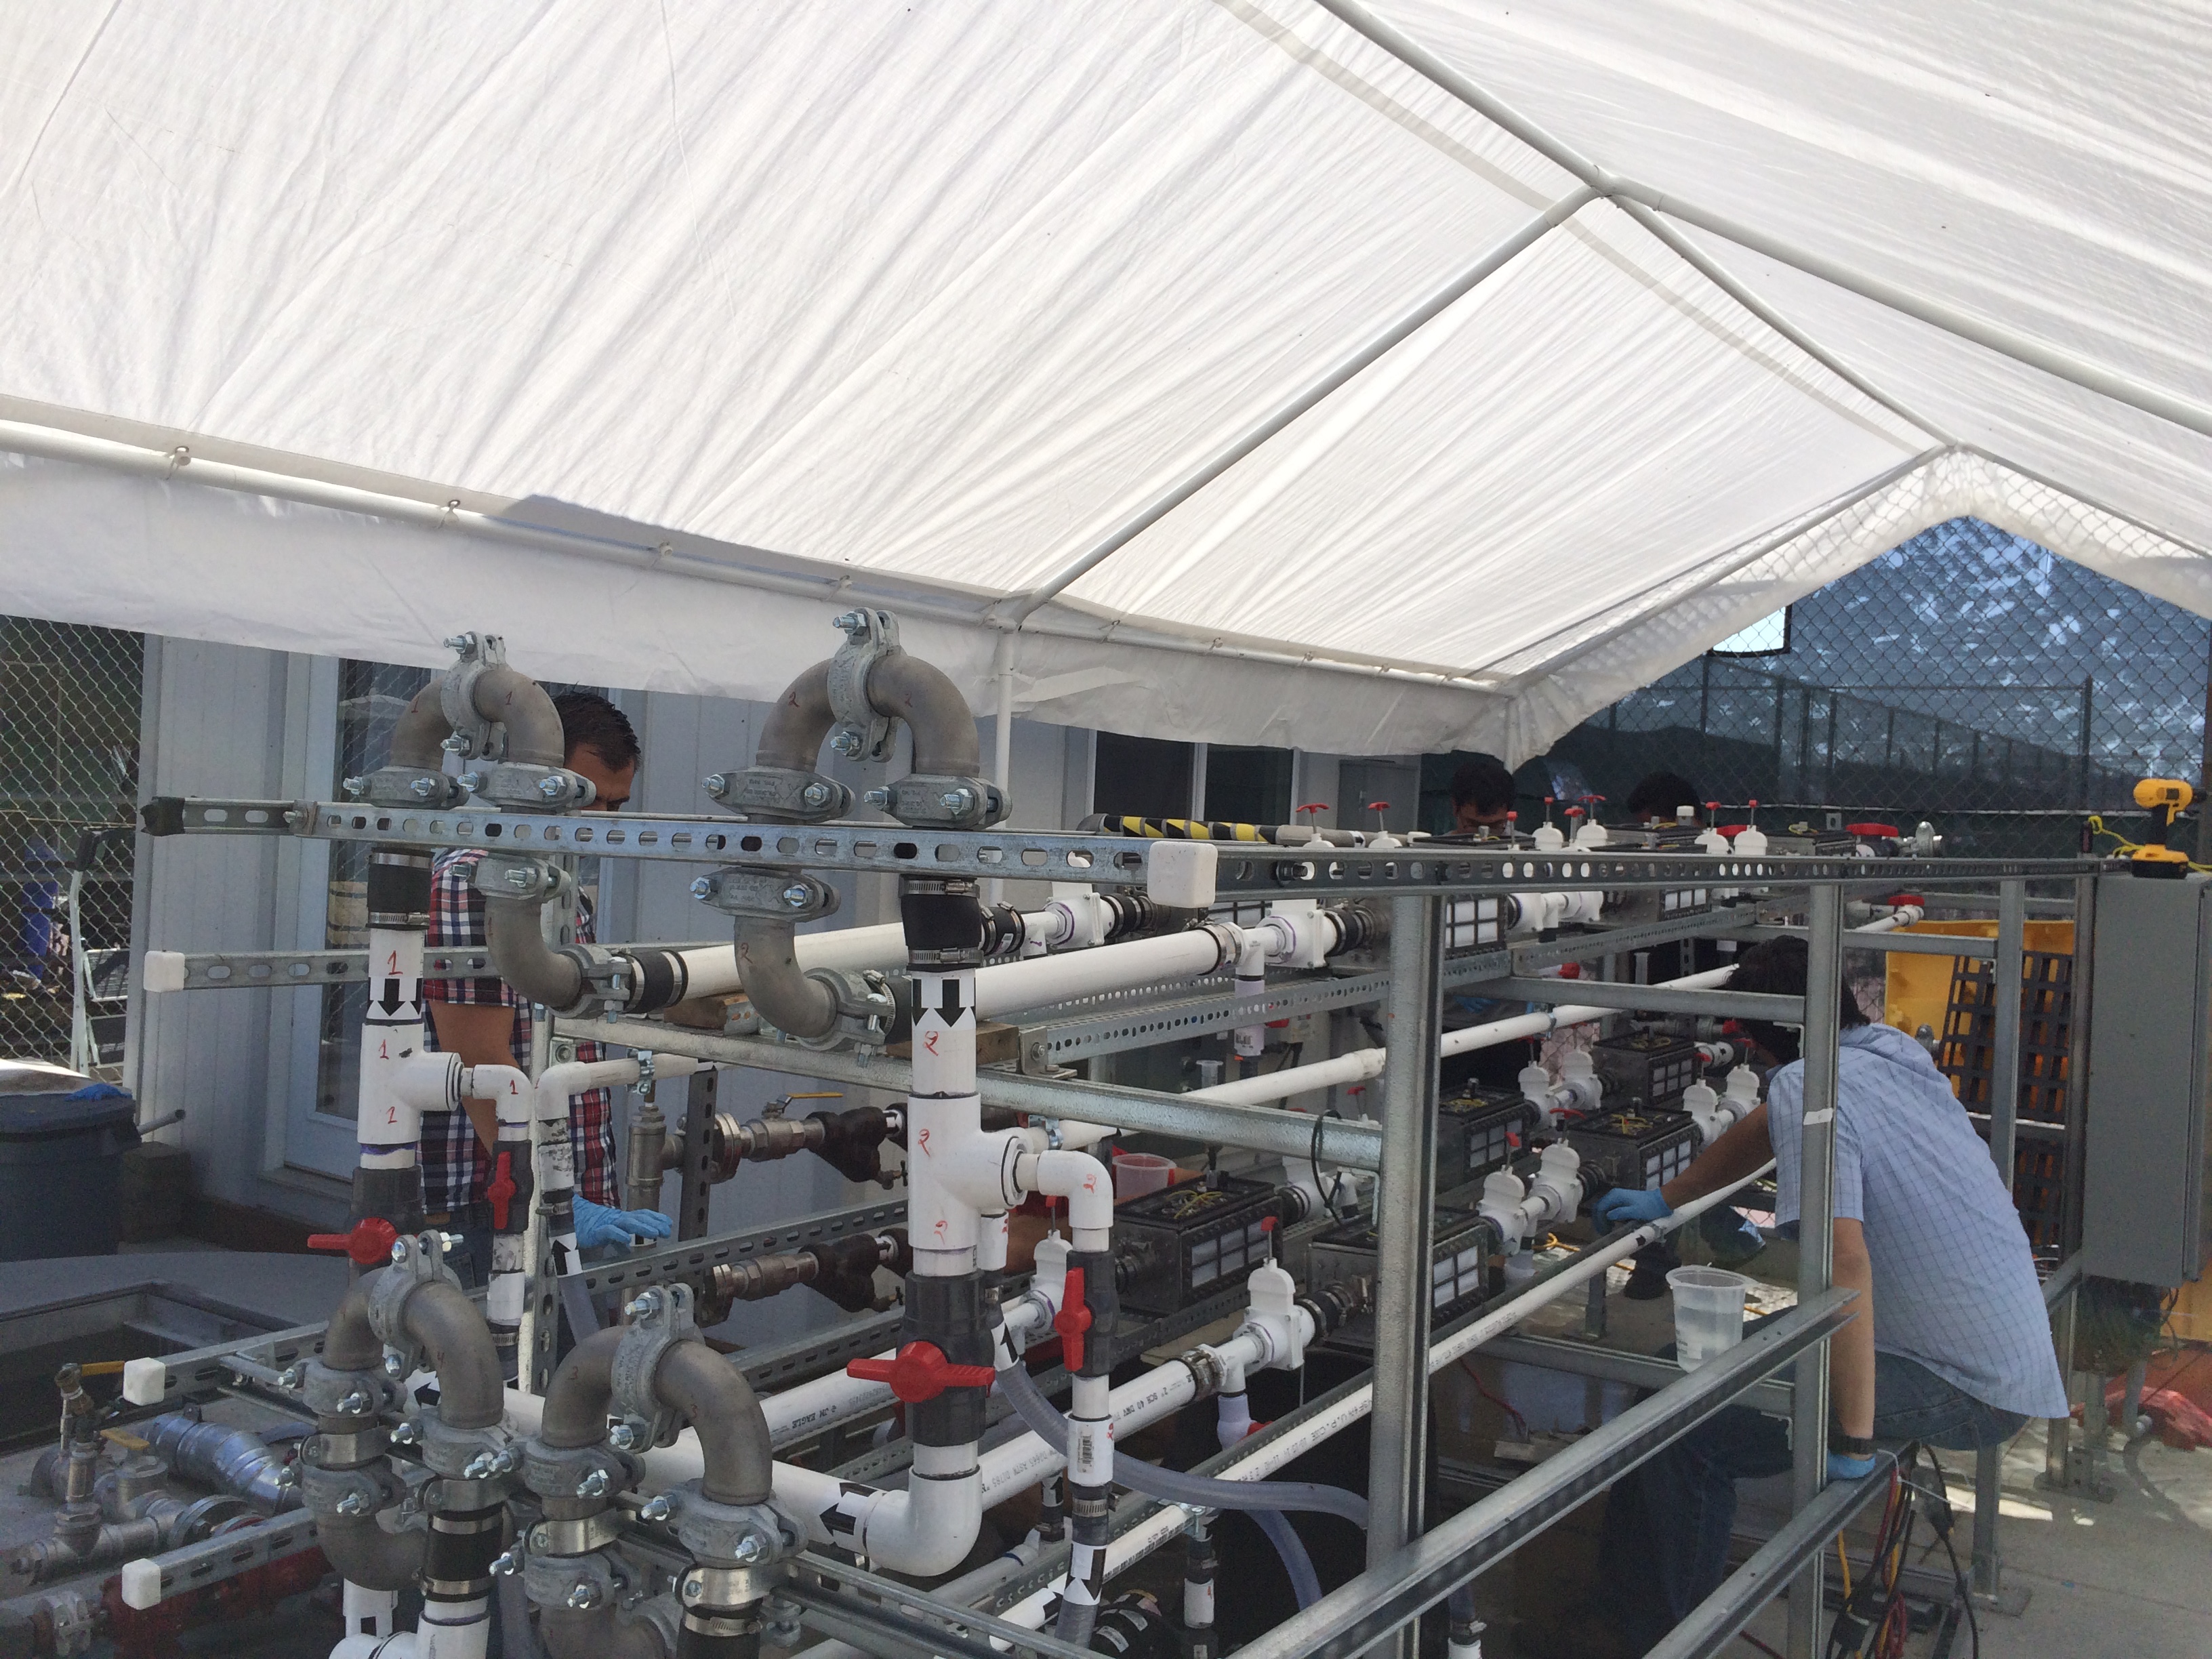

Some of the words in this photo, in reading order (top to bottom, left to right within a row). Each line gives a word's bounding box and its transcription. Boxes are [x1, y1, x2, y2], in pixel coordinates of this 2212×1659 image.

[411, 695, 418, 713] 1
[506, 691, 513, 705] 1
[788, 691, 800, 708] 2
[387, 950, 403, 975] 1
[740, 942, 754, 964] 2
[378, 1039, 389, 1059] 1
[922, 1030, 939, 1057] 2
[509, 1079, 518, 1094] 1
[386, 1106, 398, 1124] 1
[918, 1128, 930, 1158] 2
[1083, 1173, 1097, 1193] 2
[792, 1412, 816, 1429] EAGLE
